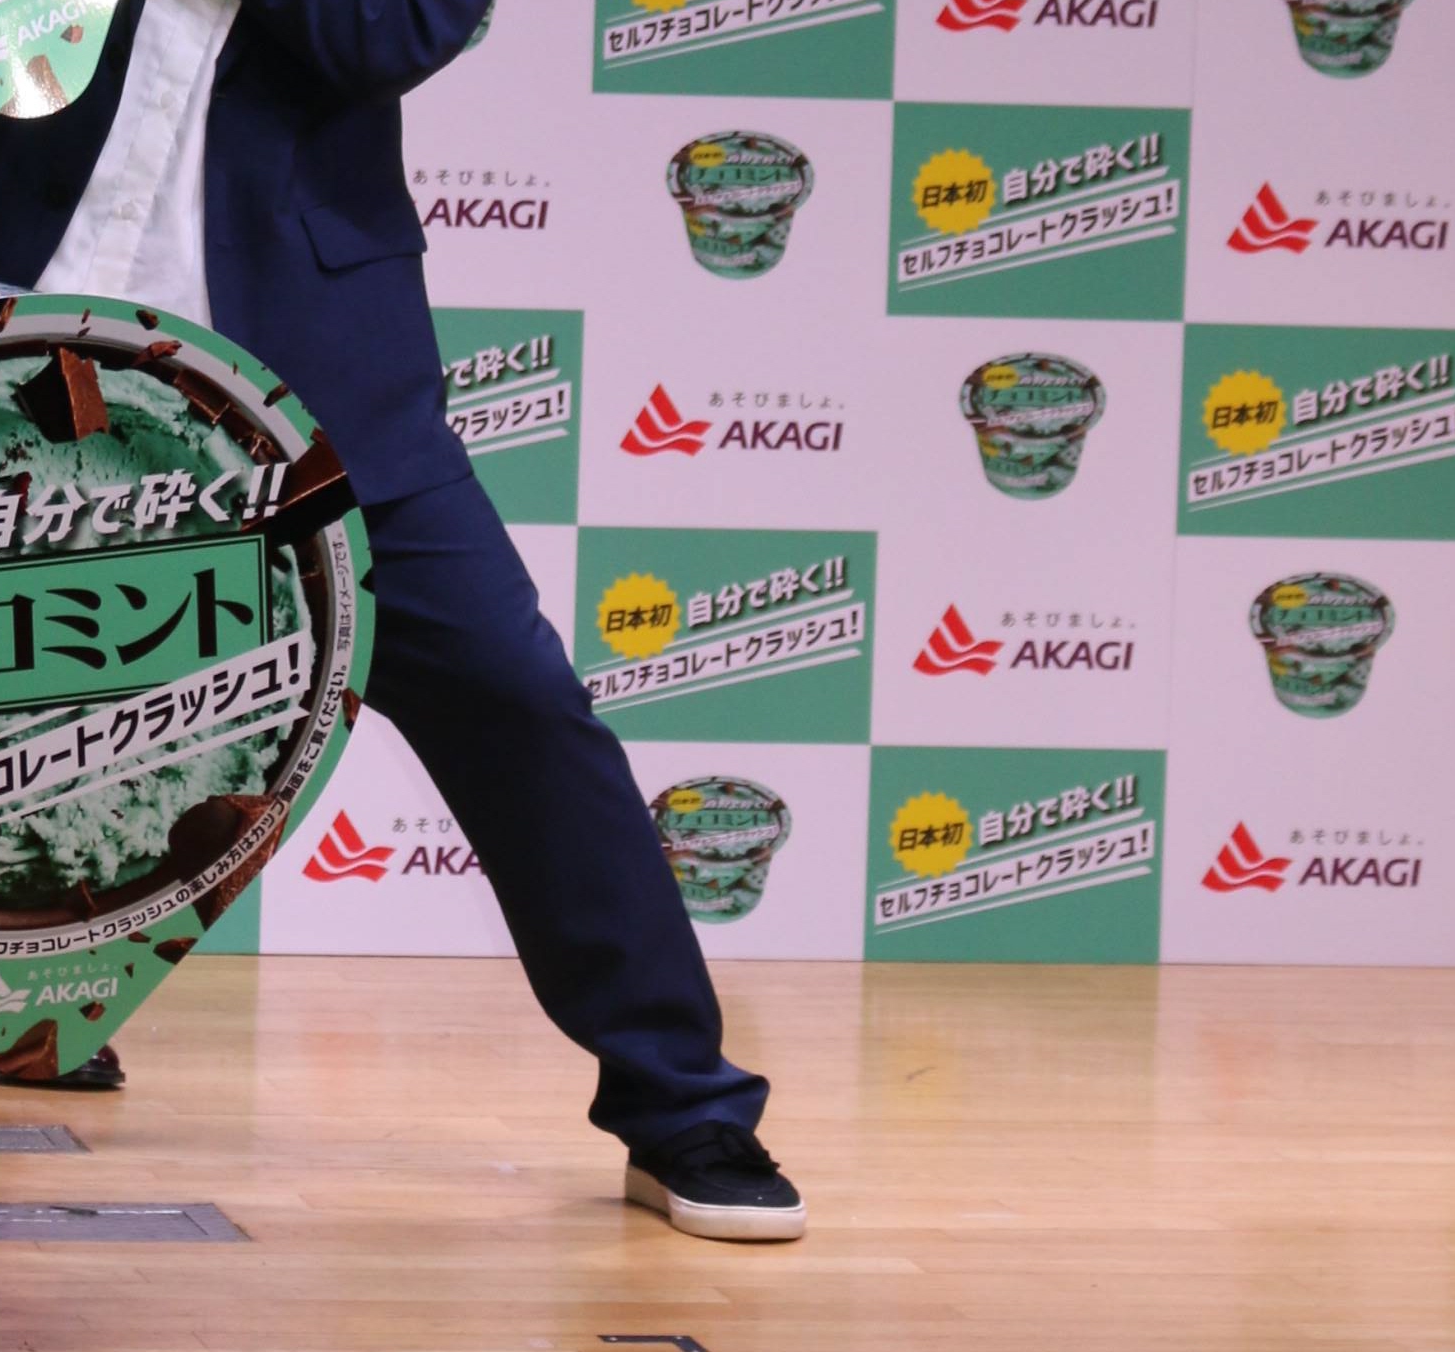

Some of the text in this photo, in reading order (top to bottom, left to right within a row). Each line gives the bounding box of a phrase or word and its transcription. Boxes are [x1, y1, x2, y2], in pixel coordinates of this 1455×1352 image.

[920, 178, 988, 209] 日本初
[420, 197, 549, 230] AKAGI
[1323, 217, 1449, 250] AKAGI
[443, 334, 549, 394] で砕く!!
[1212, 399, 1279, 430] 日本初
[716, 420, 844, 452] AKAGI
[604, 603, 672, 634] 日本初
[1008, 640, 1135, 671] AKAGI
[897, 821, 964, 852] 日本初
[1297, 857, 1422, 888] AKAGI
[34, 970, 119, 1008] AKAGI
